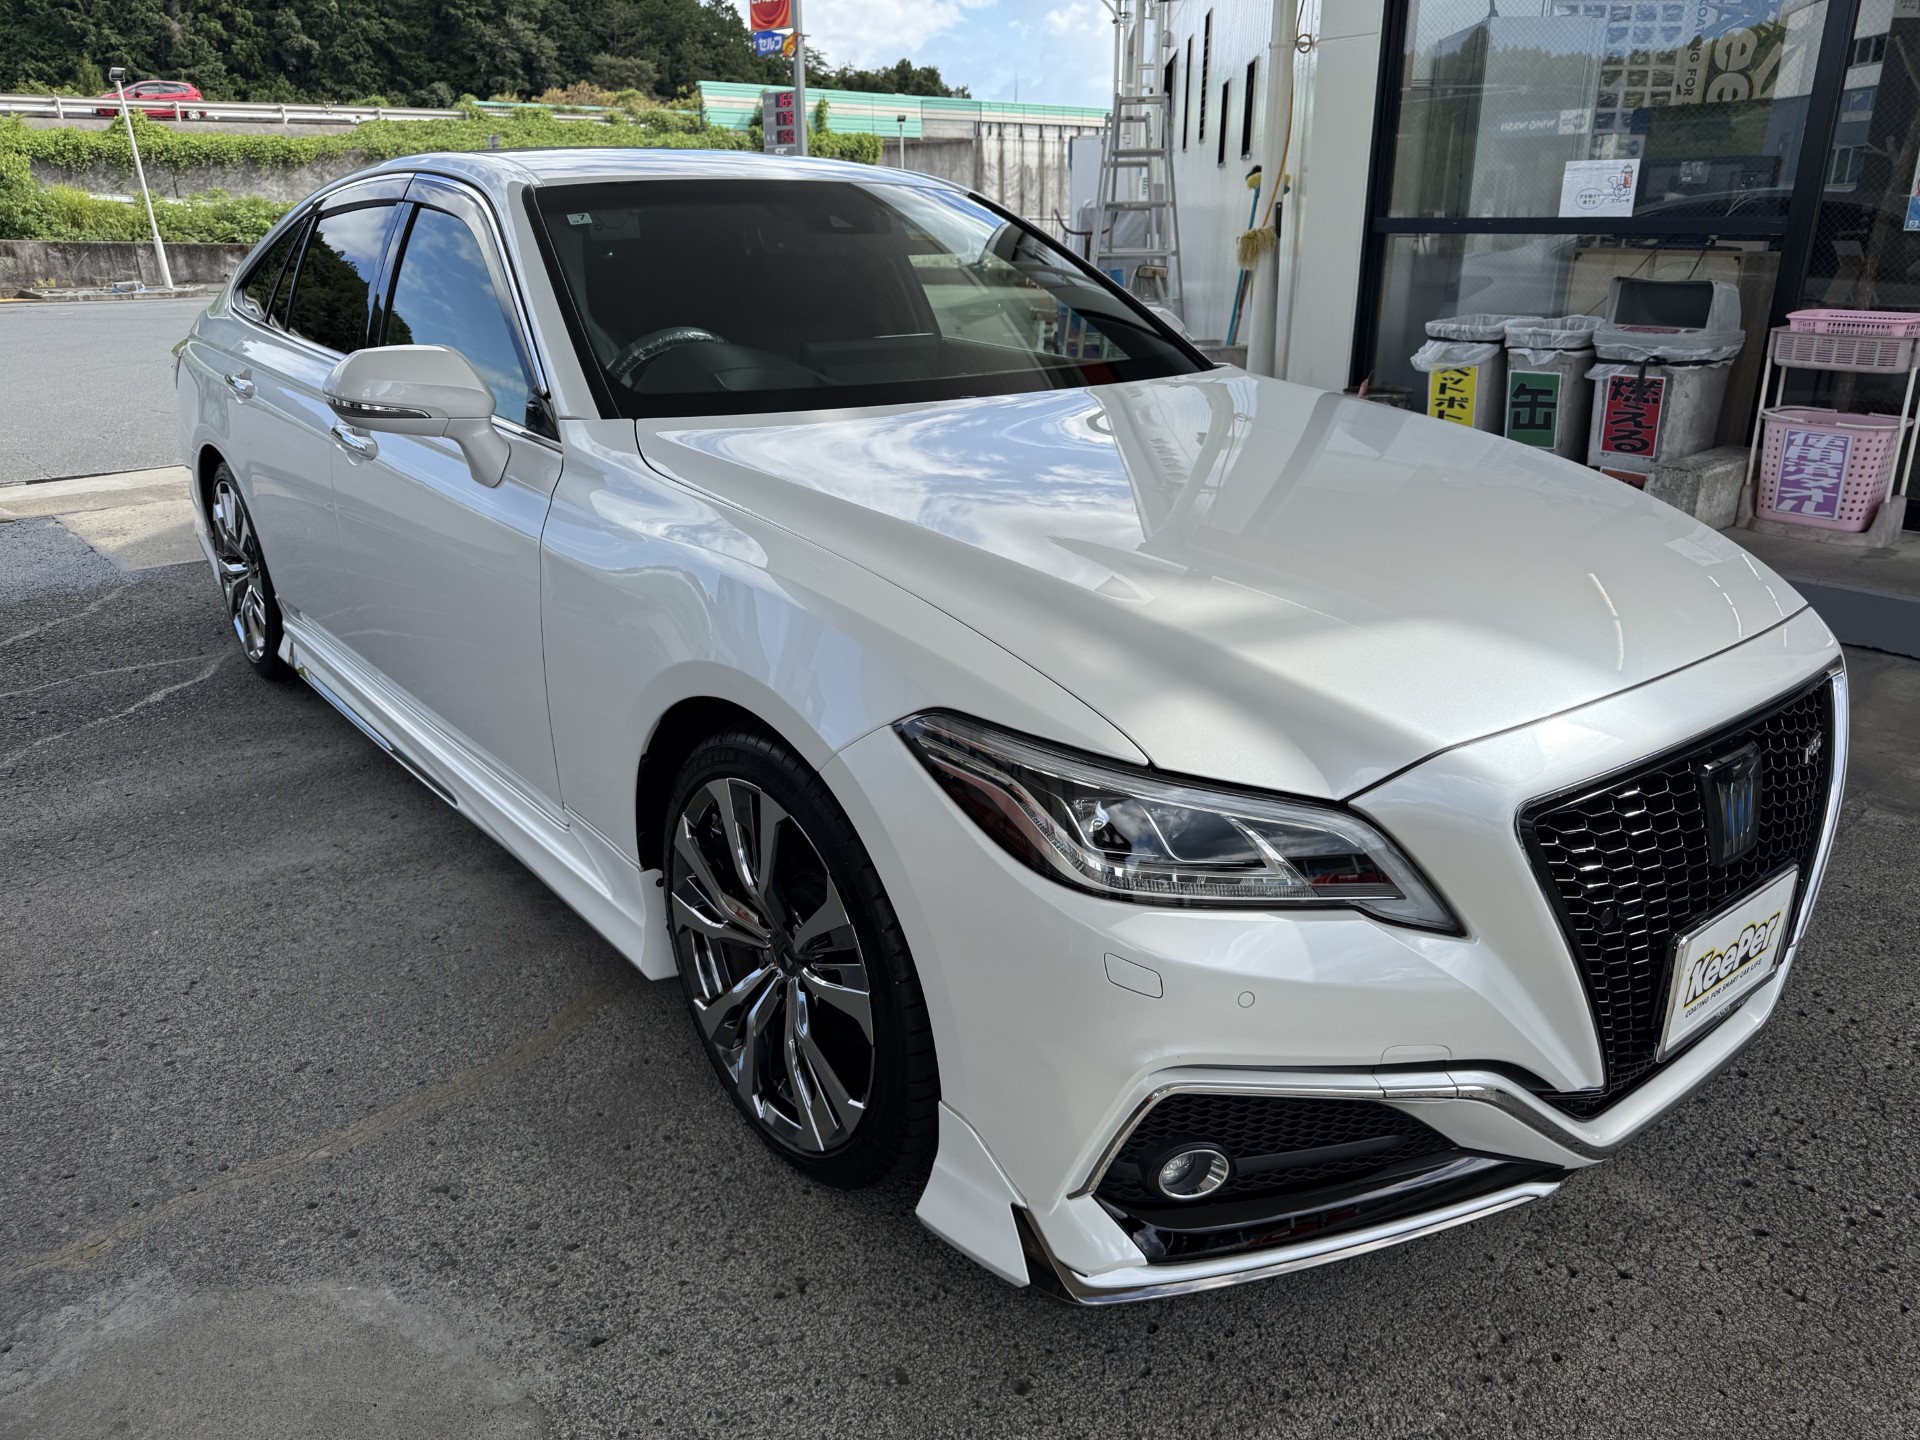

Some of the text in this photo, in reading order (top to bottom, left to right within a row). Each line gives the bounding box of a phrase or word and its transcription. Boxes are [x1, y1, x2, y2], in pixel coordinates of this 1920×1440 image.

[758, 35, 783, 52] セルフ
[1682, 68, 1698, 97] FOR
[1511, 382, 1557, 431] 缶
[1608, 377, 1662, 453] 燃える
[1777, 432, 1848, 515] 使用済タオル
[1684, 912, 1780, 1008] KeePer
[1685, 996, 1710, 1018] COATING
[1710, 988, 1721, 1001] FOR
[1722, 975, 1740, 992] SMART
[1740, 966, 1750, 979] CAR
[1750, 958, 1762, 971] LIFE
